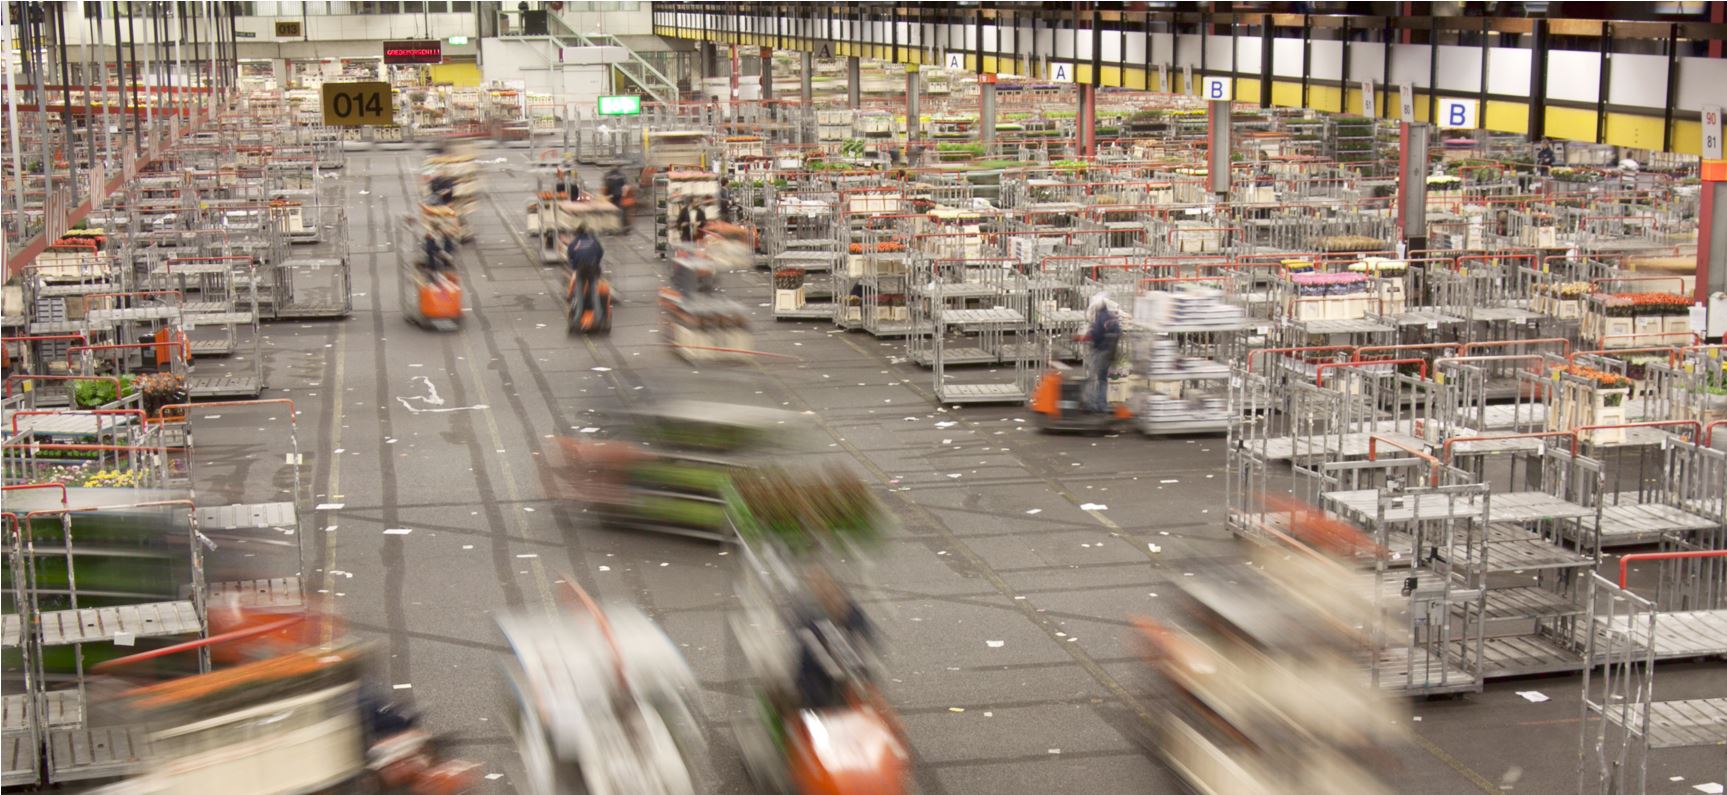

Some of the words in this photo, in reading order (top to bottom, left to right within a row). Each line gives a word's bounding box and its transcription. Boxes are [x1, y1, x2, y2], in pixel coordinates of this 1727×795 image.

[279, 24, 297, 34] 013
[818, 44, 832, 58] A
[950, 55, 959, 68] A
[1056, 65, 1066, 79] A
[1211, 81, 1223, 98] B
[333, 92, 384, 118] 014
[1449, 103, 1466, 126] B
[1706, 112, 1716, 125] 90
[1707, 135, 1716, 148] 81
